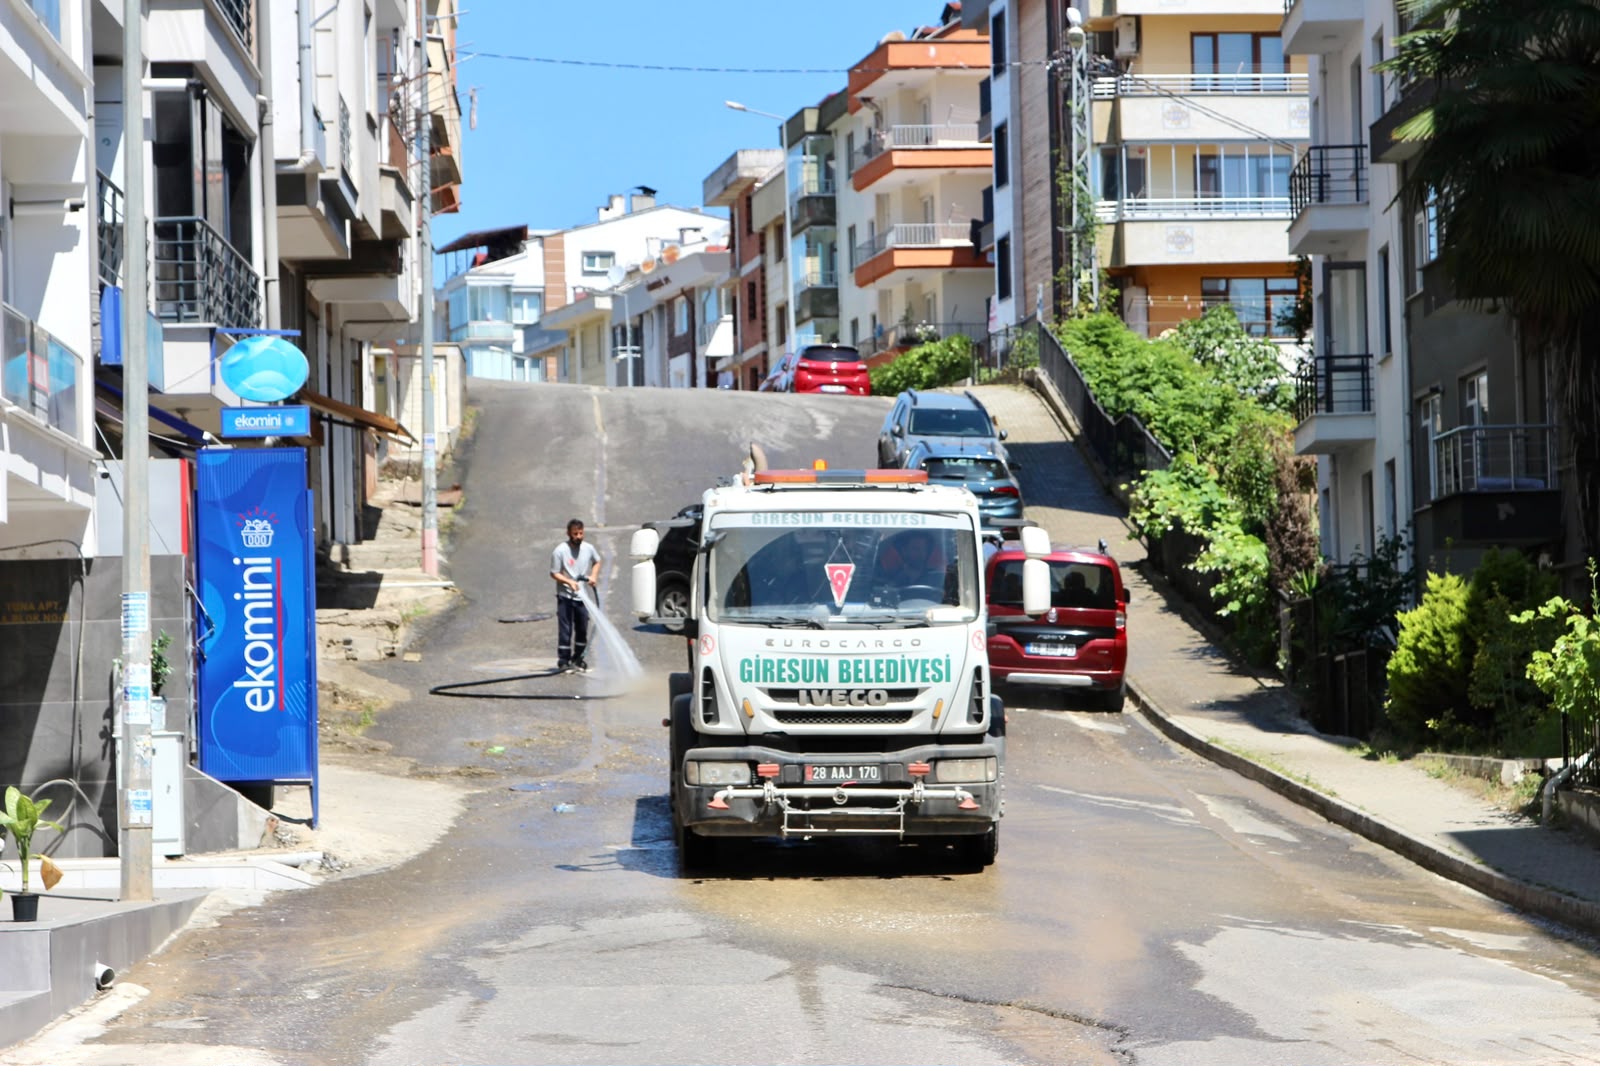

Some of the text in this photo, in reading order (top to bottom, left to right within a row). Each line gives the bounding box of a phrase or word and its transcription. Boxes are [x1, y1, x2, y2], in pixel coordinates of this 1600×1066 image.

[234, 413, 282, 428] ekomini
[232, 557, 276, 712] ekomini
[765, 638, 921, 648] EUROCARGO
[739, 654, 951, 683] GİRESUN BELEDİYESİ
[798, 689, 889, 706] IVECO
[812, 766, 878, 779] 28 AAJ 170
